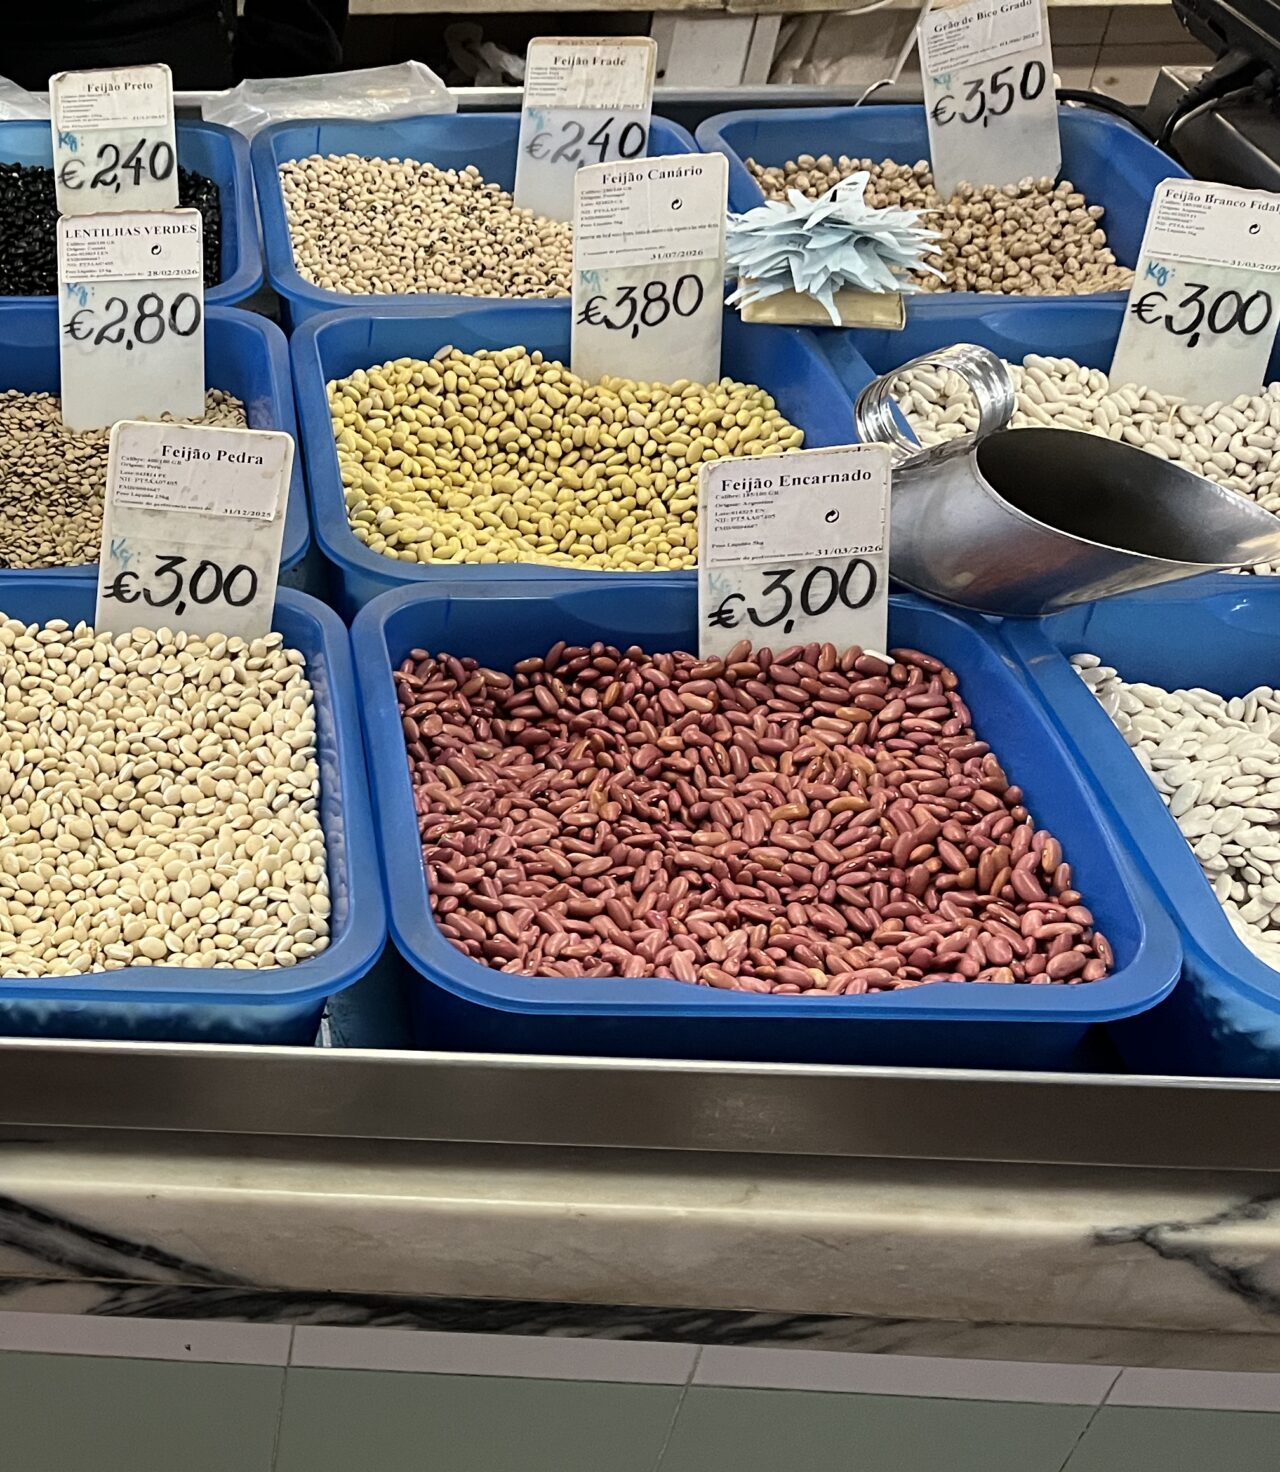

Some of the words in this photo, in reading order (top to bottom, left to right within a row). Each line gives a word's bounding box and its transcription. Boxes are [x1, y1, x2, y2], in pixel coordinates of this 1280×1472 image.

[934, 20, 959, 33] Grão
[962, 16, 972, 25] de
[977, 9, 997, 21] Bico
[554, 56, 589, 69] Feijão
[592, 56, 626, 66] Frade
[87, 83, 120, 93] Feijão
[124, 82, 153, 91] Preto
[930, 60, 1046, 128] €3,50
[525, 117, 646, 169] €2,40
[58, 138, 175, 194] €2,40
[602, 173, 643, 186] Feijão
[648, 166, 703, 181] Canário
[1165, 189, 1201, 203] Feijão
[1204, 194, 1246, 208] Branco
[1250, 200, 1280, 215] Fidal
[65, 226, 141, 239] LENTILHAS
[144, 224, 197, 236] VERDES
[63, 292, 201, 350] €2,80
[576, 274, 704, 339] €3,80
[1131, 283, 1272, 348] €3,00
[162, 445, 211, 462] Feijão
[216, 450, 264, 465] Pedra
[721, 478, 772, 494] Feijão
[779, 469, 872, 487] Encarnado
[102, 555, 258, 616] €3,00
[708, 558, 877, 634] €3,00
